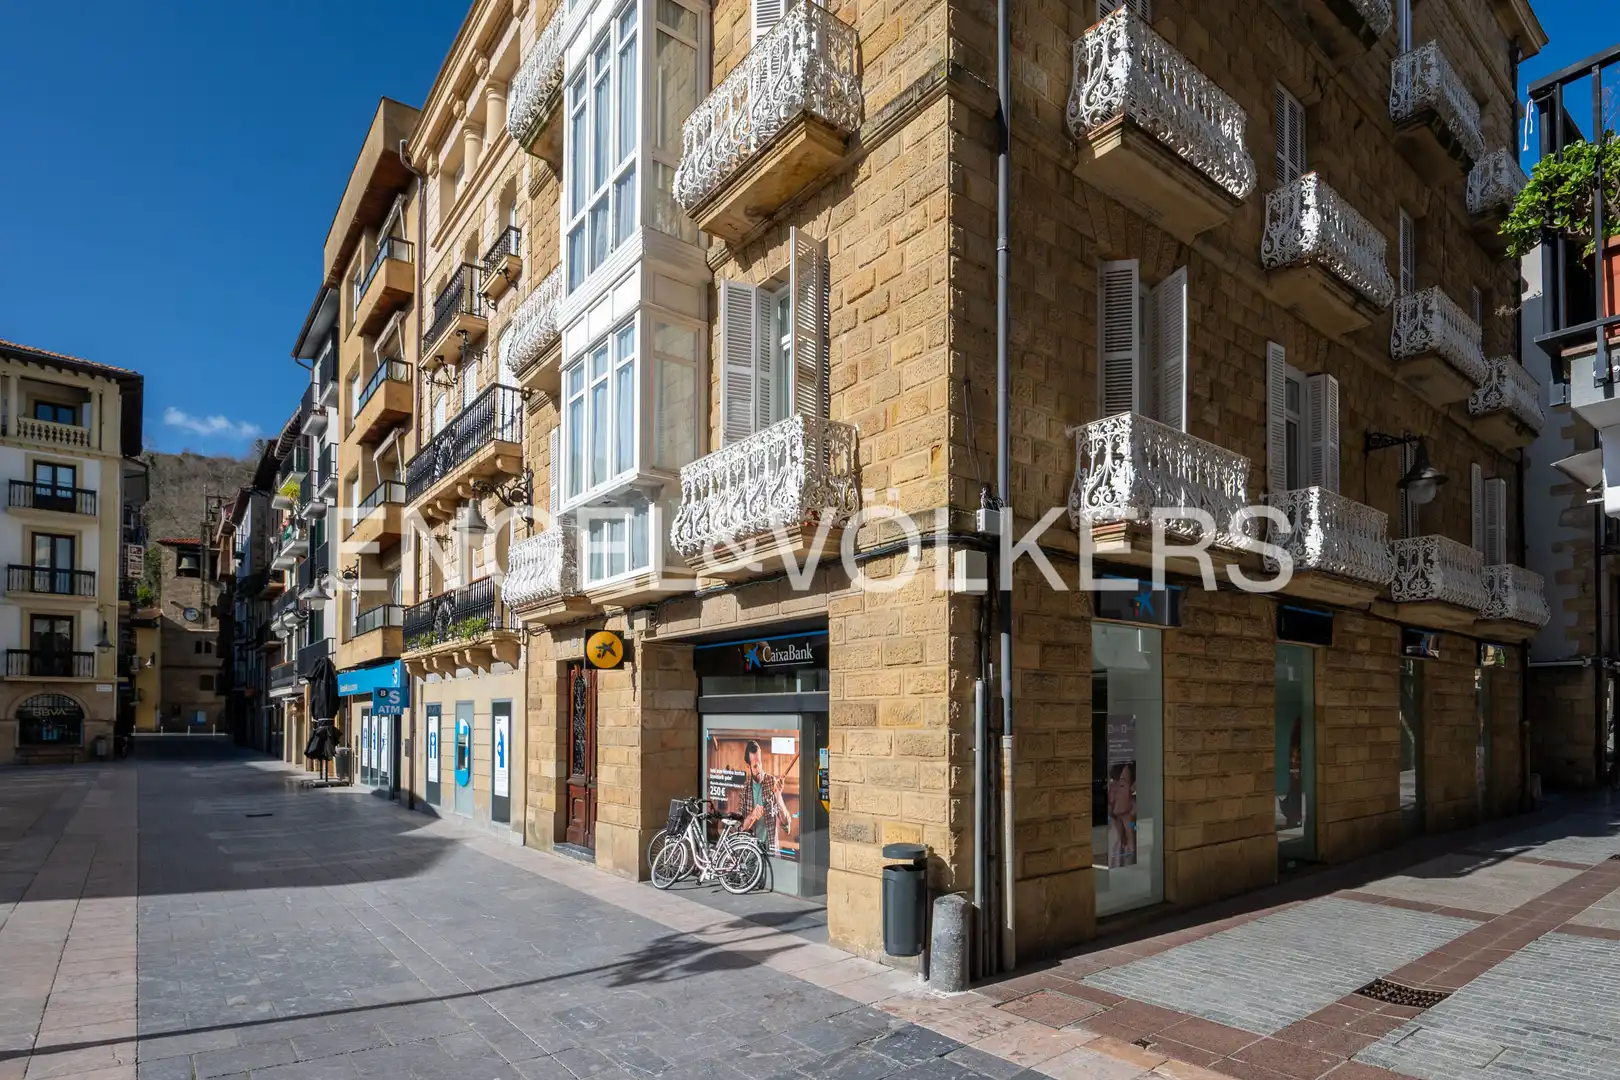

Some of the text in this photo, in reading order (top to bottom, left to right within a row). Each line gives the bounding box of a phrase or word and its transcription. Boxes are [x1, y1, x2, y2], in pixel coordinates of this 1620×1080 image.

[763, 642, 813, 662] CaixaBank
[32, 708, 67, 717] BBVA
[378, 705, 401, 714] ATM
[710, 786, 722, 796] 250
